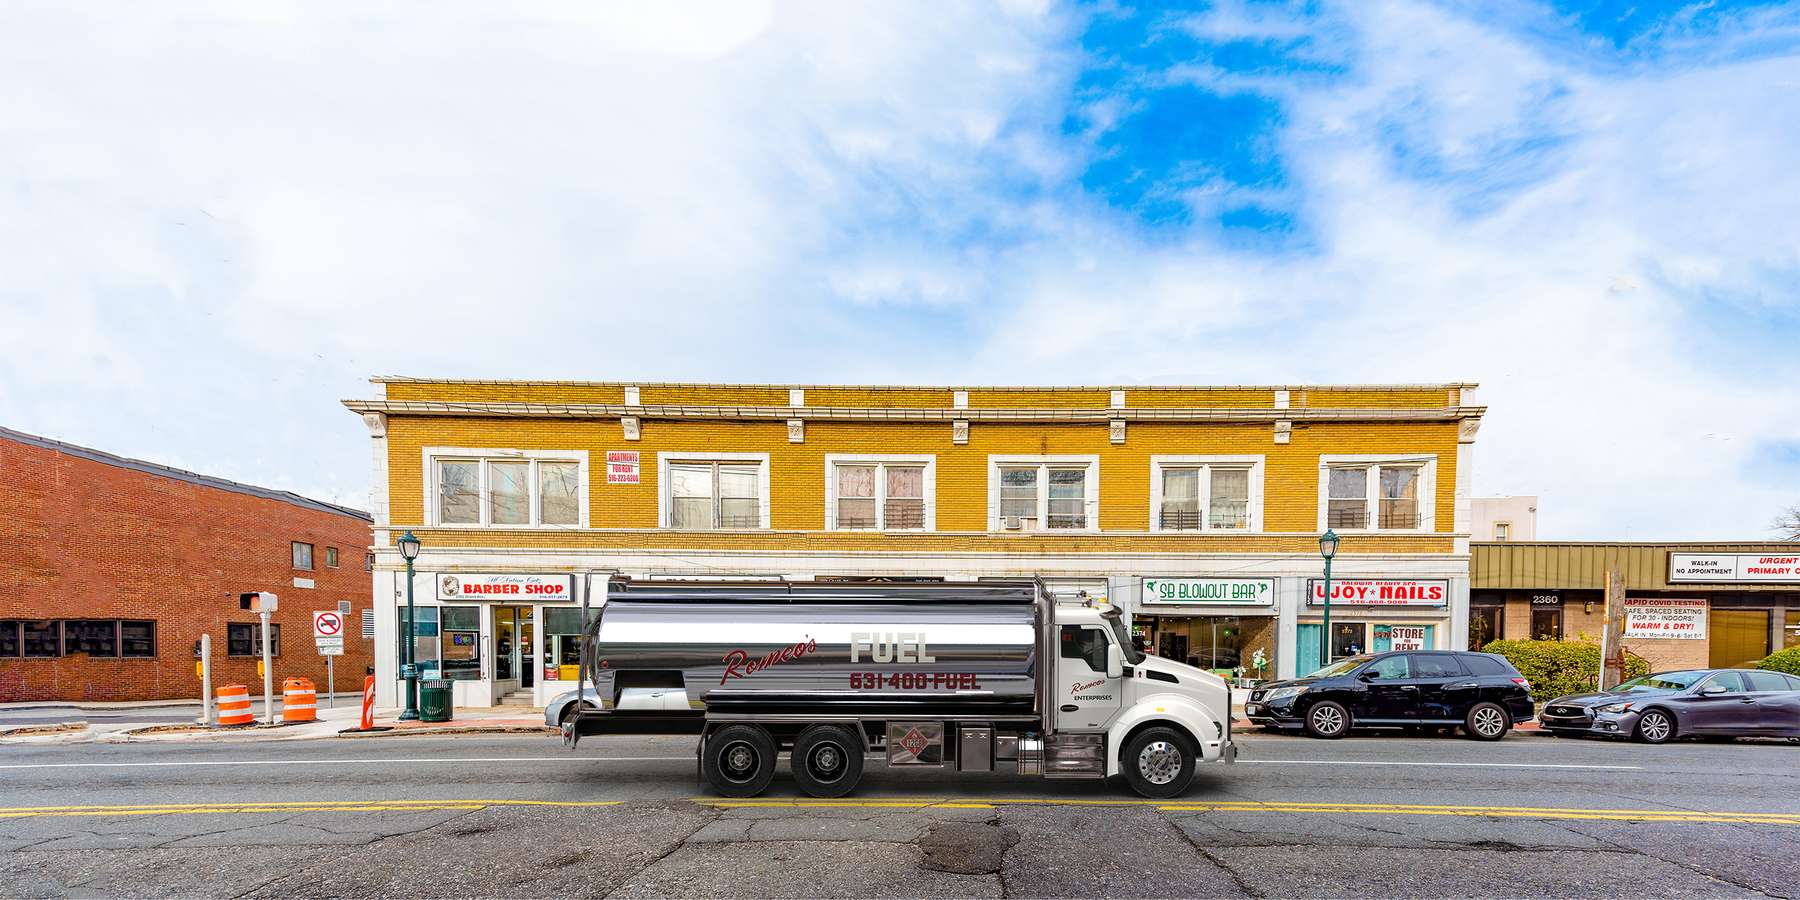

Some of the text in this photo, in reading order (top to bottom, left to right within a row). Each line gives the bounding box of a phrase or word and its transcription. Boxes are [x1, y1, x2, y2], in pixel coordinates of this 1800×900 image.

[608, 452, 638, 462] APARTMENTS
[612, 464, 633, 472] FOR RENT
[1759, 557, 1799, 565] URGENT
[1747, 567, 1791, 575] PRIMARY
[463, 584, 563, 594] BARBER SHOP
[1160, 583, 1256, 599] SB BLOWOUT BAR
[1380, 586, 1442, 600] NAILS
[1533, 595, 1558, 604] 2360
[1393, 628, 1424, 639] STORE
[850, 632, 936, 664] FUEL
[719, 634, 817, 686] Romeo's
[849, 672, 981, 690] 631-400-FUEL
